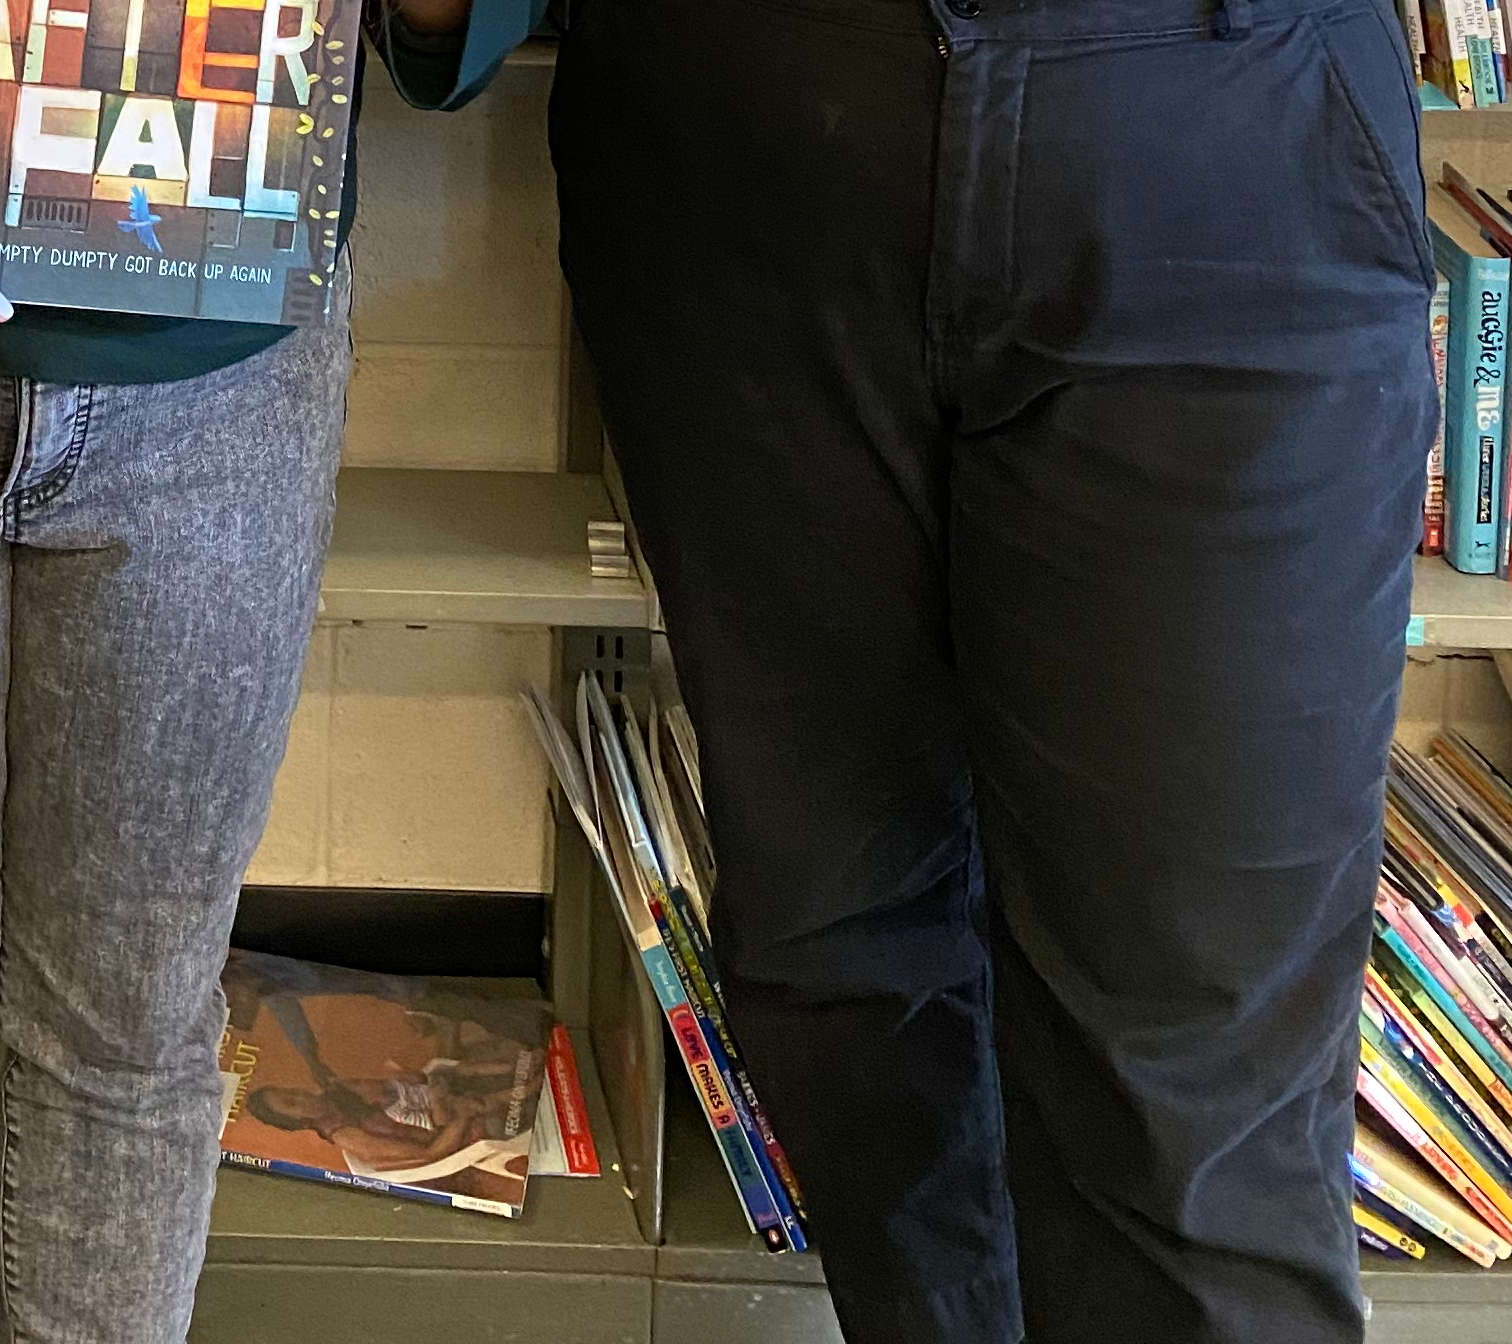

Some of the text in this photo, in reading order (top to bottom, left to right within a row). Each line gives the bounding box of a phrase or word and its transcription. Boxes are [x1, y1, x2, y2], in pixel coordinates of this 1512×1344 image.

[6, 85, 300, 228] FALL
[50, 248, 119, 272] DUMPTY
[124, 255, 153, 274] GOT
[158, 257, 197, 278] BACK
[203, 264, 224, 280] UP
[229, 265, 272, 285] AGAIN
